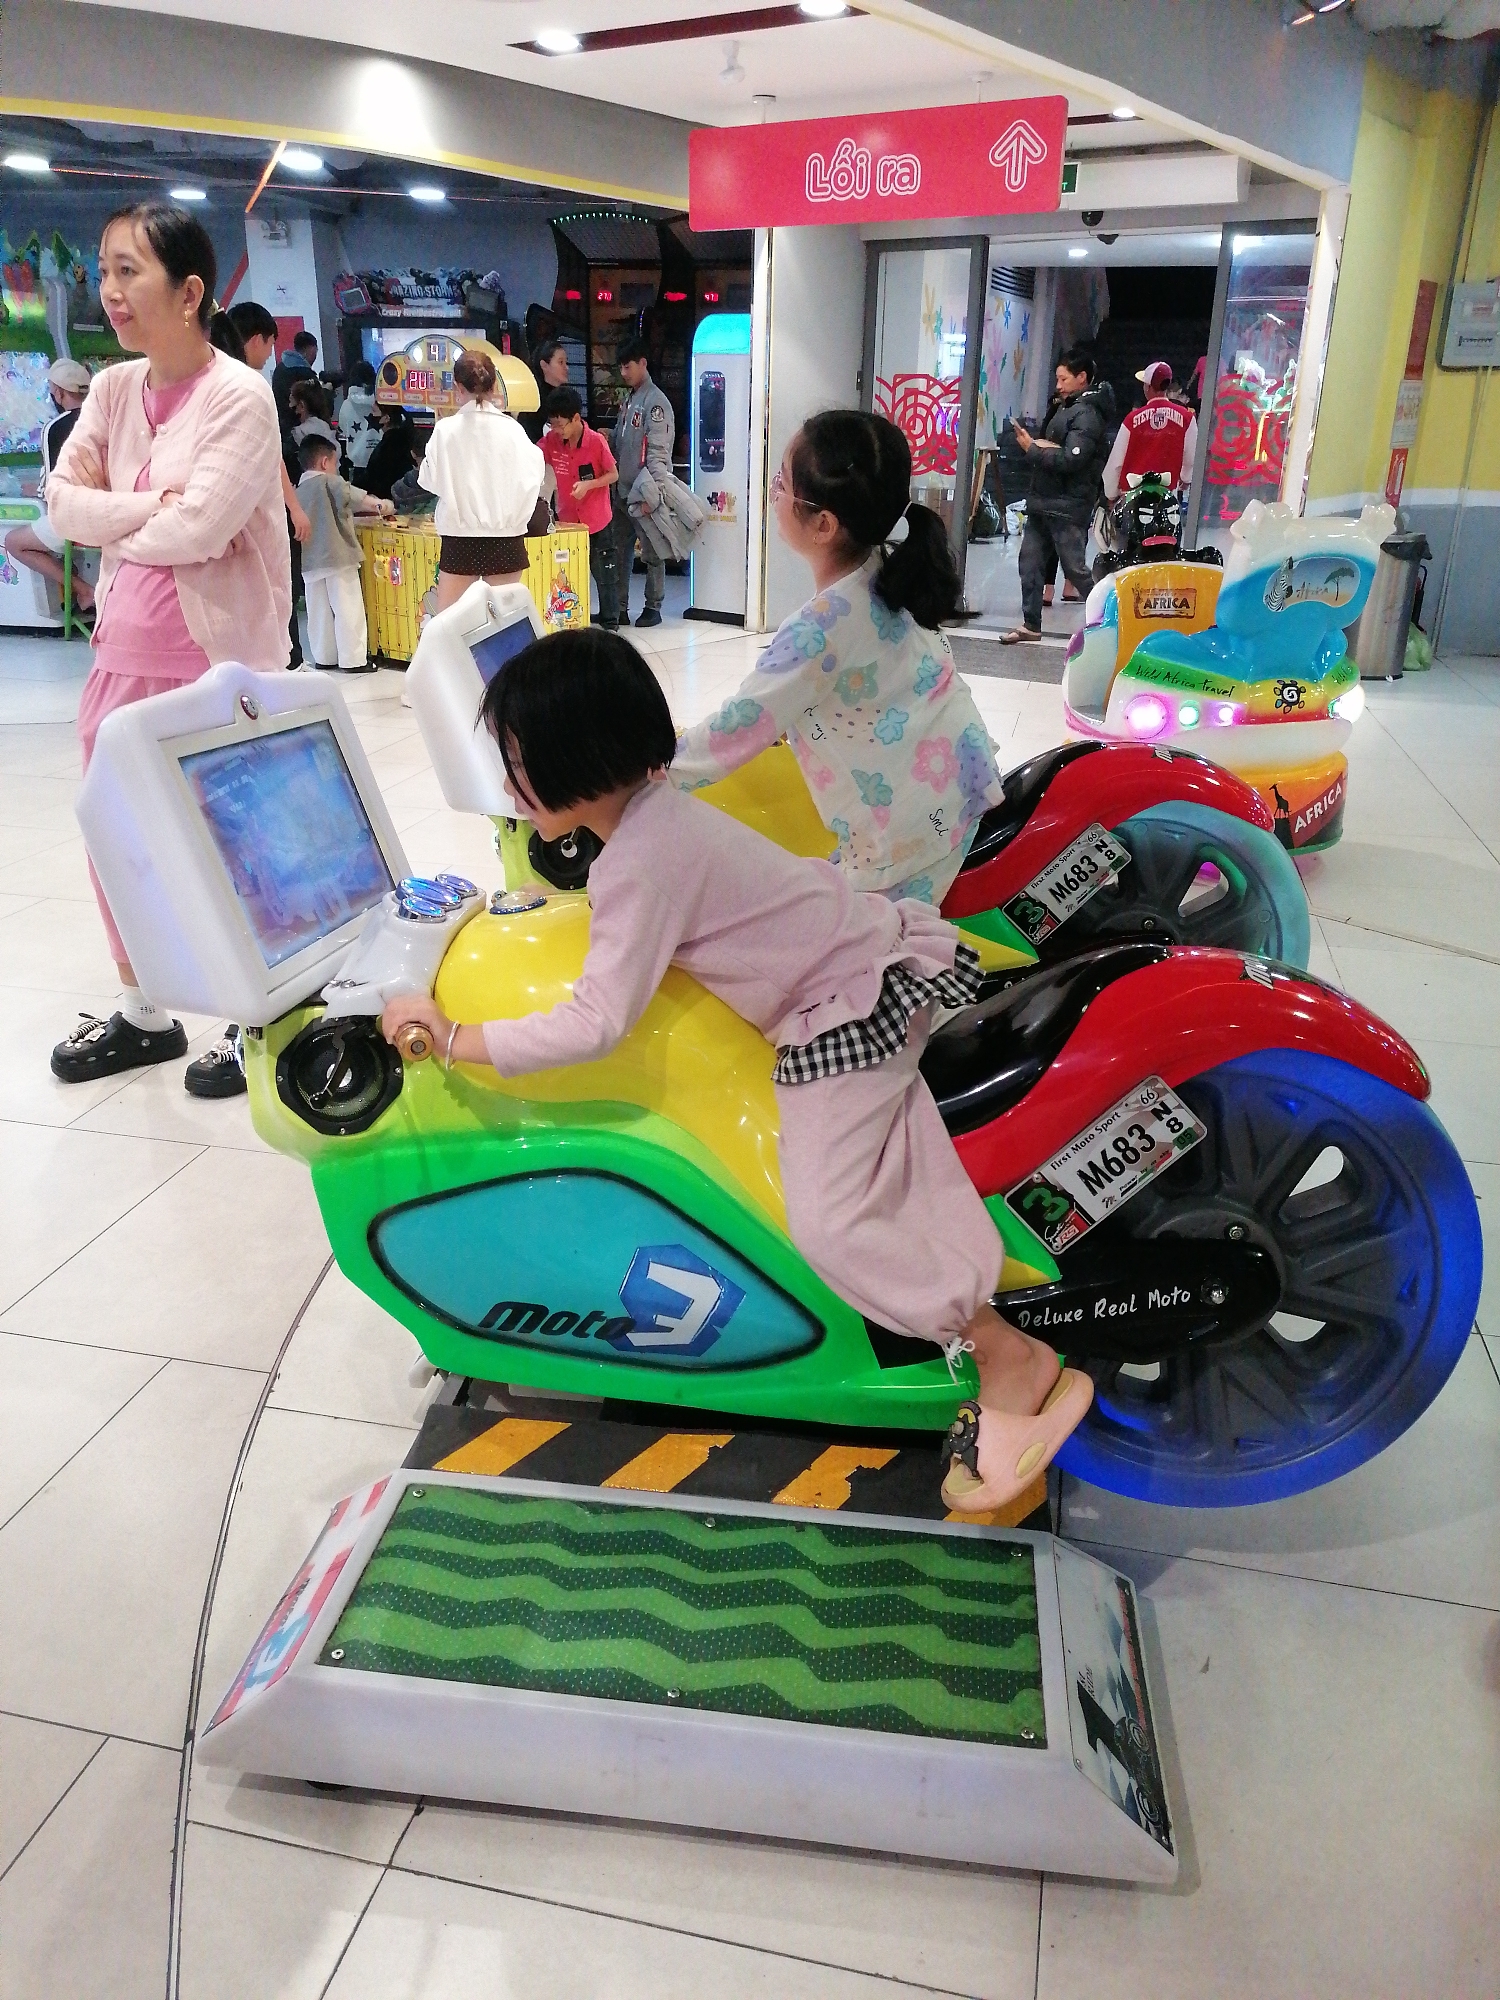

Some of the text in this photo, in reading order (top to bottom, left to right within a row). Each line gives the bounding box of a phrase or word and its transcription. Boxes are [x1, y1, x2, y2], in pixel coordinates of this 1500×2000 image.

[806, 138, 921, 202] Lối ra
[1143, 597, 1191, 610] AFRICA
[1135, 665, 1236, 698] Wild Africa Travel
[1294, 782, 1344, 834] AFRICA
[1087, 832, 1098, 843] 66
[1094, 838, 1109, 853] N
[1104, 849, 1116, 861] 8
[1048, 855, 1099, 905] M683
[1013, 900, 1045, 924] 3
[1140, 1087, 1156, 1105] 66
[1150, 1100, 1173, 1122] N
[1165, 1116, 1184, 1134] 8
[1050, 1111, 1122, 1171] First Moto Sport
[1176, 1131, 1193, 1146] 05
[1076, 1123, 1156, 1197] M683
[1022, 1186, 1070, 1222] 3
[1018, 1286, 1191, 1328] Deluxe Real Moto
